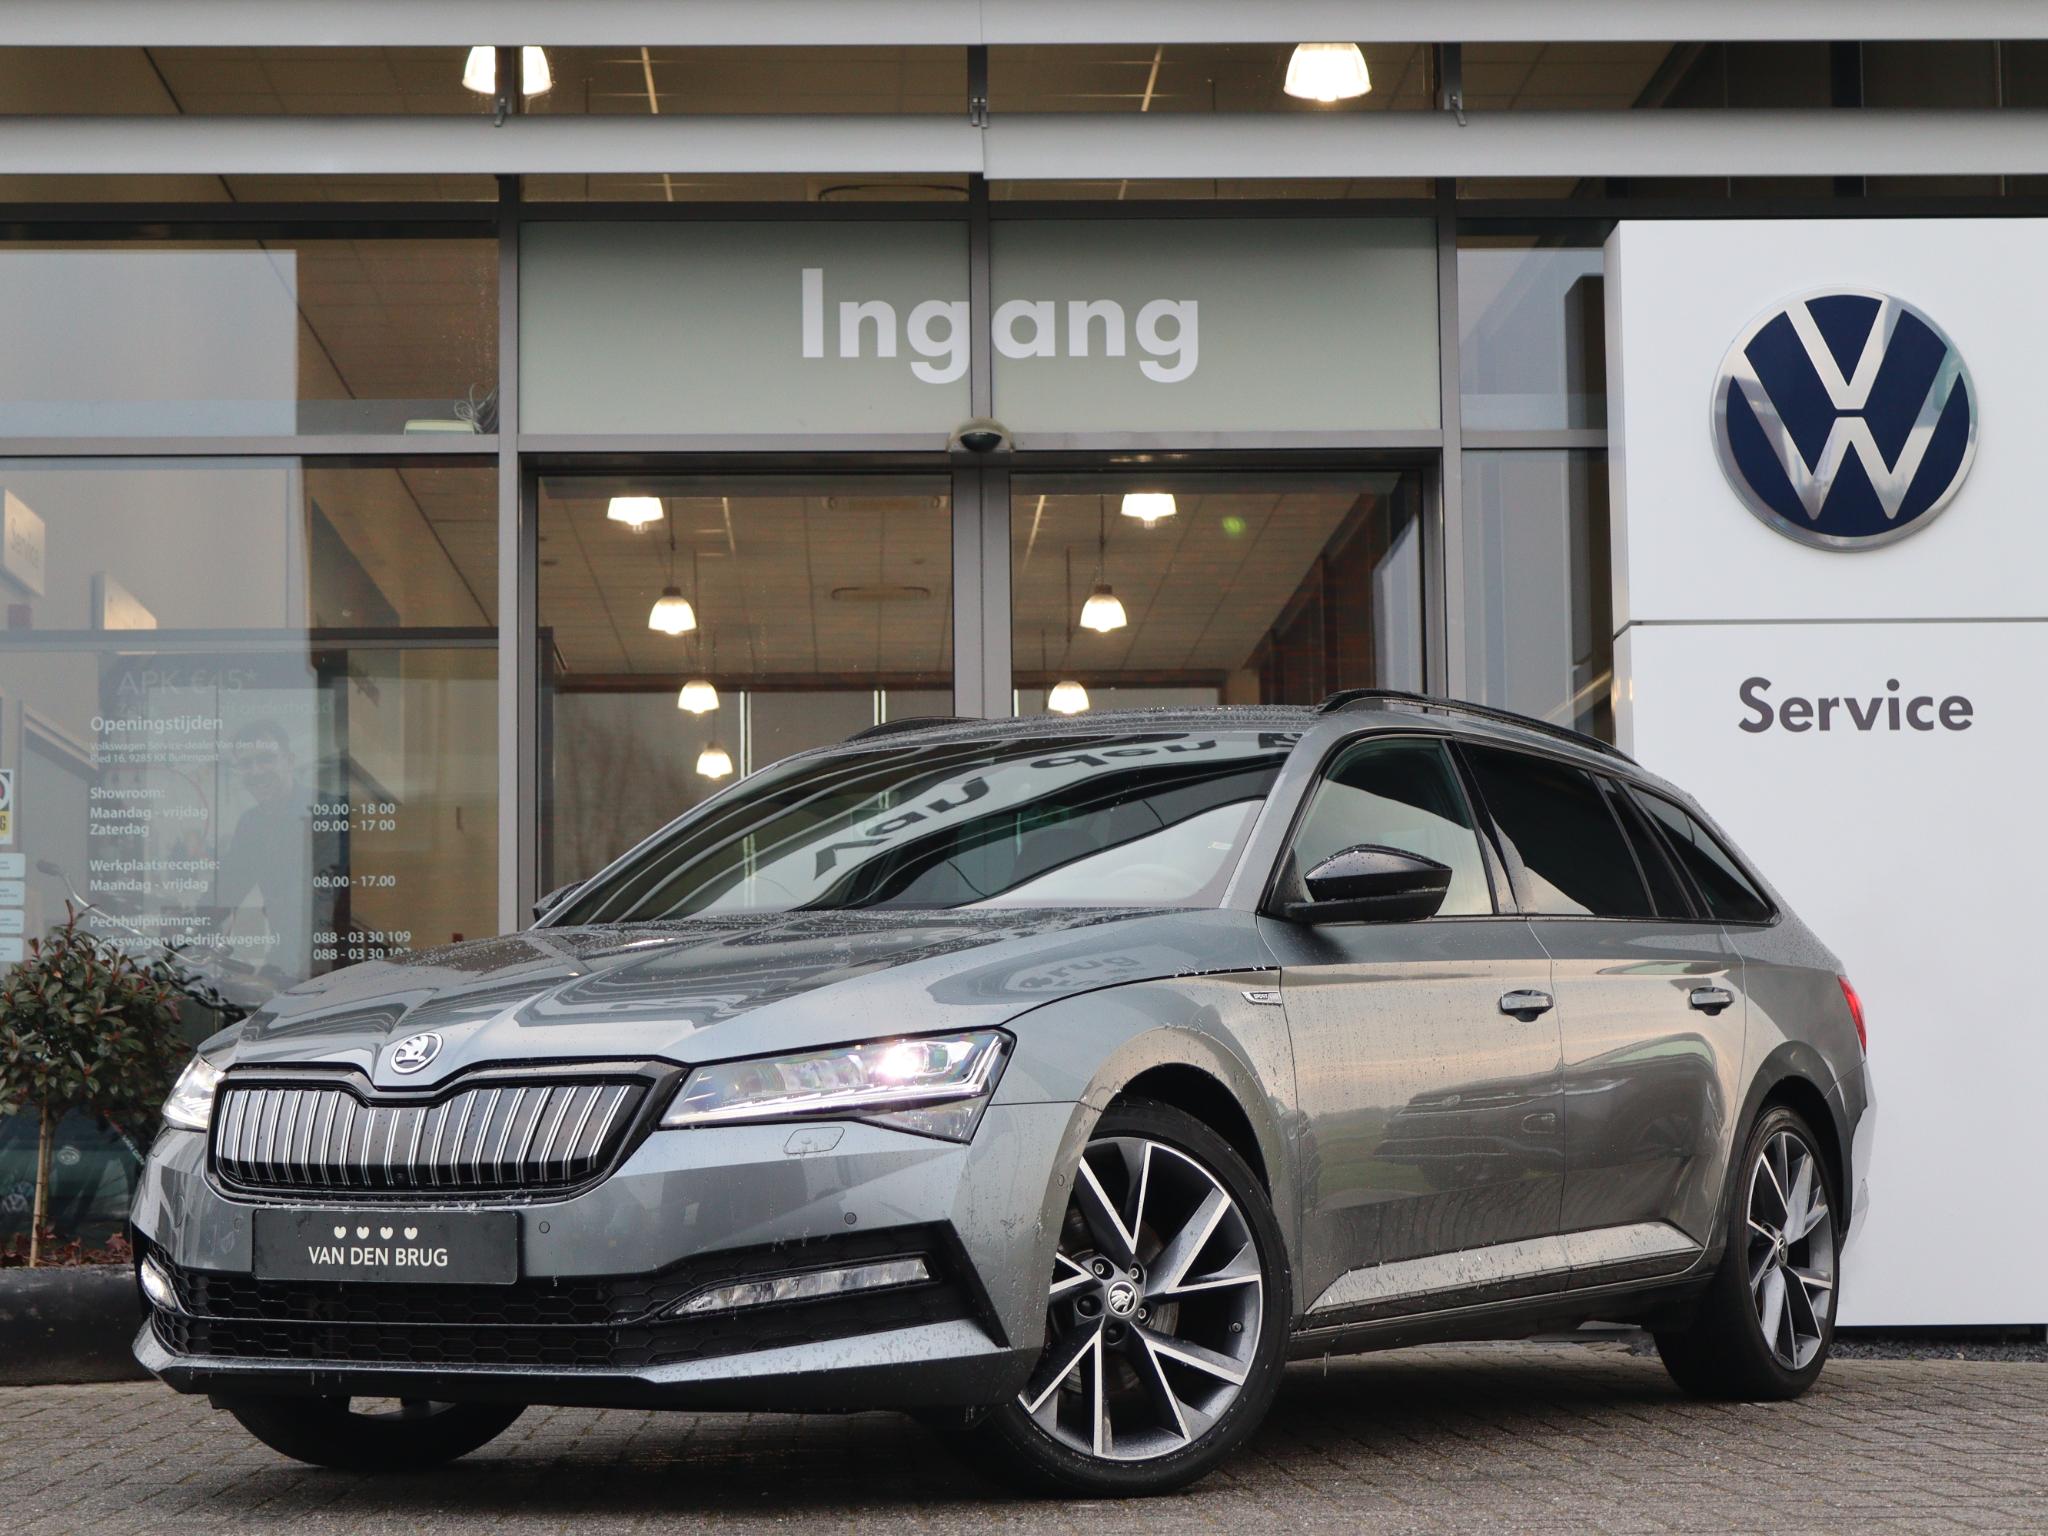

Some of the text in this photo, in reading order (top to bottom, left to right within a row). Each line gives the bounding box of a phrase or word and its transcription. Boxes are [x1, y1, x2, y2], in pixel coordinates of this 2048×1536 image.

[802, 268, 1199, 384] Ingang
[1737, 676, 1974, 733] Service
[90, 715, 224, 735] Openingstijden
[89, 741, 146, 753] Volkswagen
[129, 752, 152, 763] 9285
[90, 787, 166, 800] Showroom:
[90, 807, 152, 821] Maandag
[163, 806, 208, 821] vrijdag
[313, 803, 350, 816] 09.00
[90, 823, 150, 837] Zaterdag
[313, 820, 350, 832] 09.00
[89, 859, 220, 873] Werkplaatsreceptie:
[90, 879, 152, 894] Maandag
[163, 878, 208, 894] vrijdag
[313, 876, 350, 888] 08.00
[360, 875, 396, 888] 17.00
[89, 915, 211, 930] Pechhulpnummer:
[313, 932, 338, 944] 088
[348, 932, 365, 943] 03
[368, 931, 384, 943] 30
[388, 930, 412, 943] 109
[313, 949, 338, 961] 088
[348, 948, 365, 961] 03
[368, 948, 384, 960] 30
[307, 1245, 448, 1268] VAN DEN BRUG
